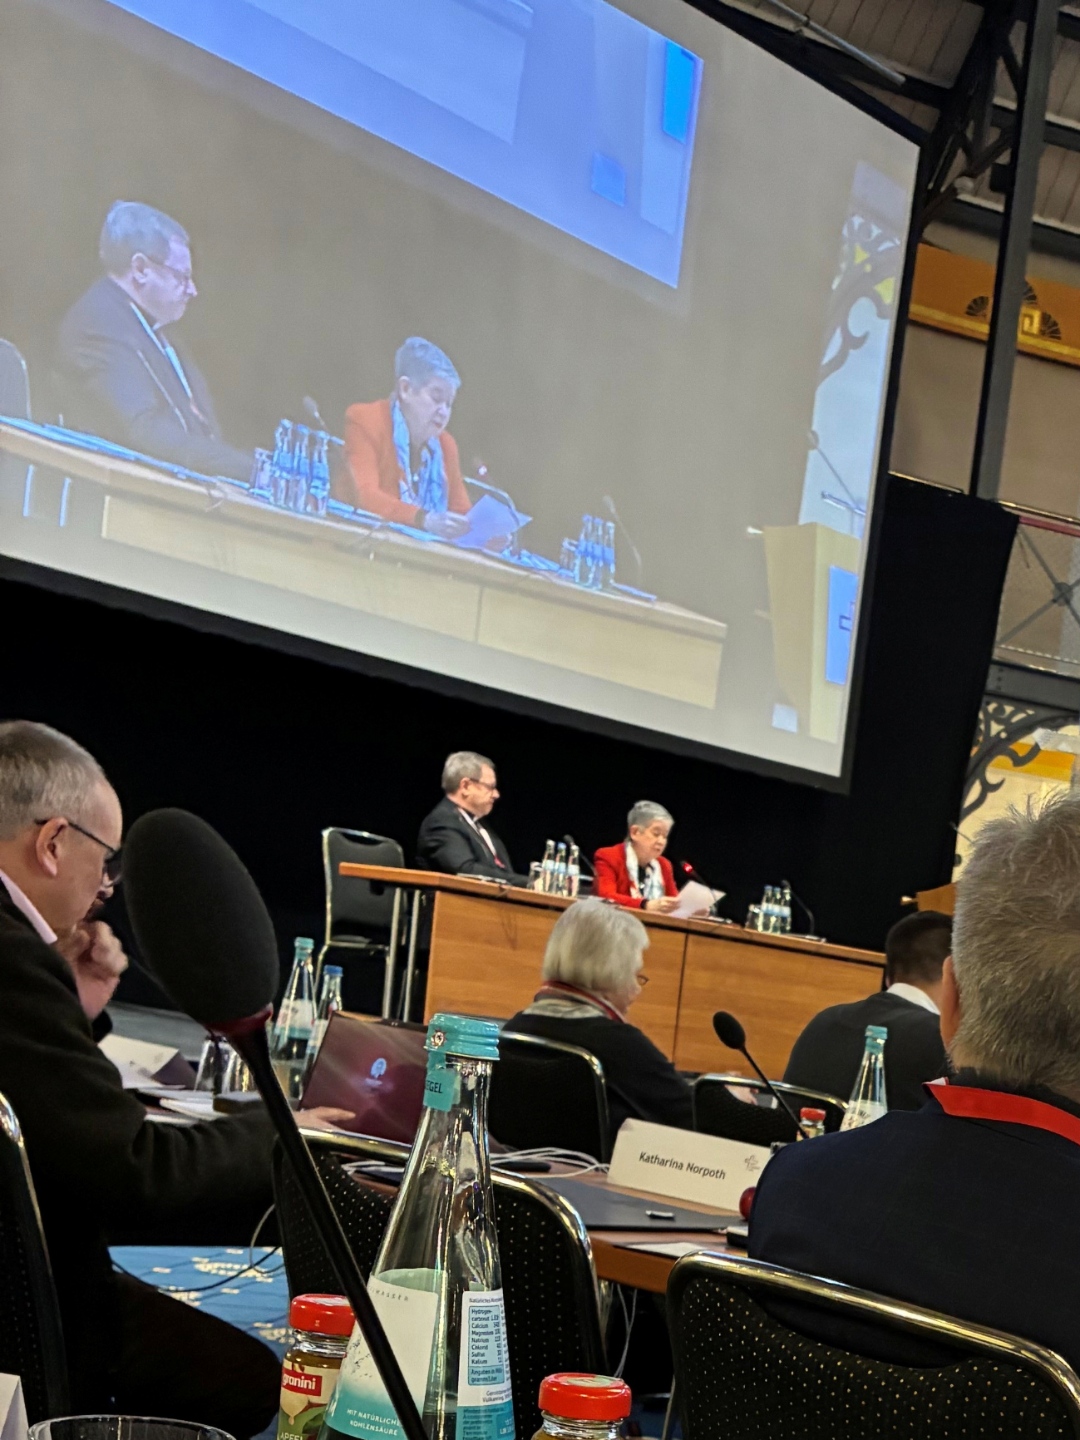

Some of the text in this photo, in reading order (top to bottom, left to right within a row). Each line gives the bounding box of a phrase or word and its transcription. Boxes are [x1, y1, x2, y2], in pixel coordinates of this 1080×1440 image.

[639, 1151, 684, 1171] Katharina
[686, 1162, 727, 1180] Norpoth
[282, 1373, 316, 1390] granini
[358, 1411, 401, 1427] NATÜRLICHE
